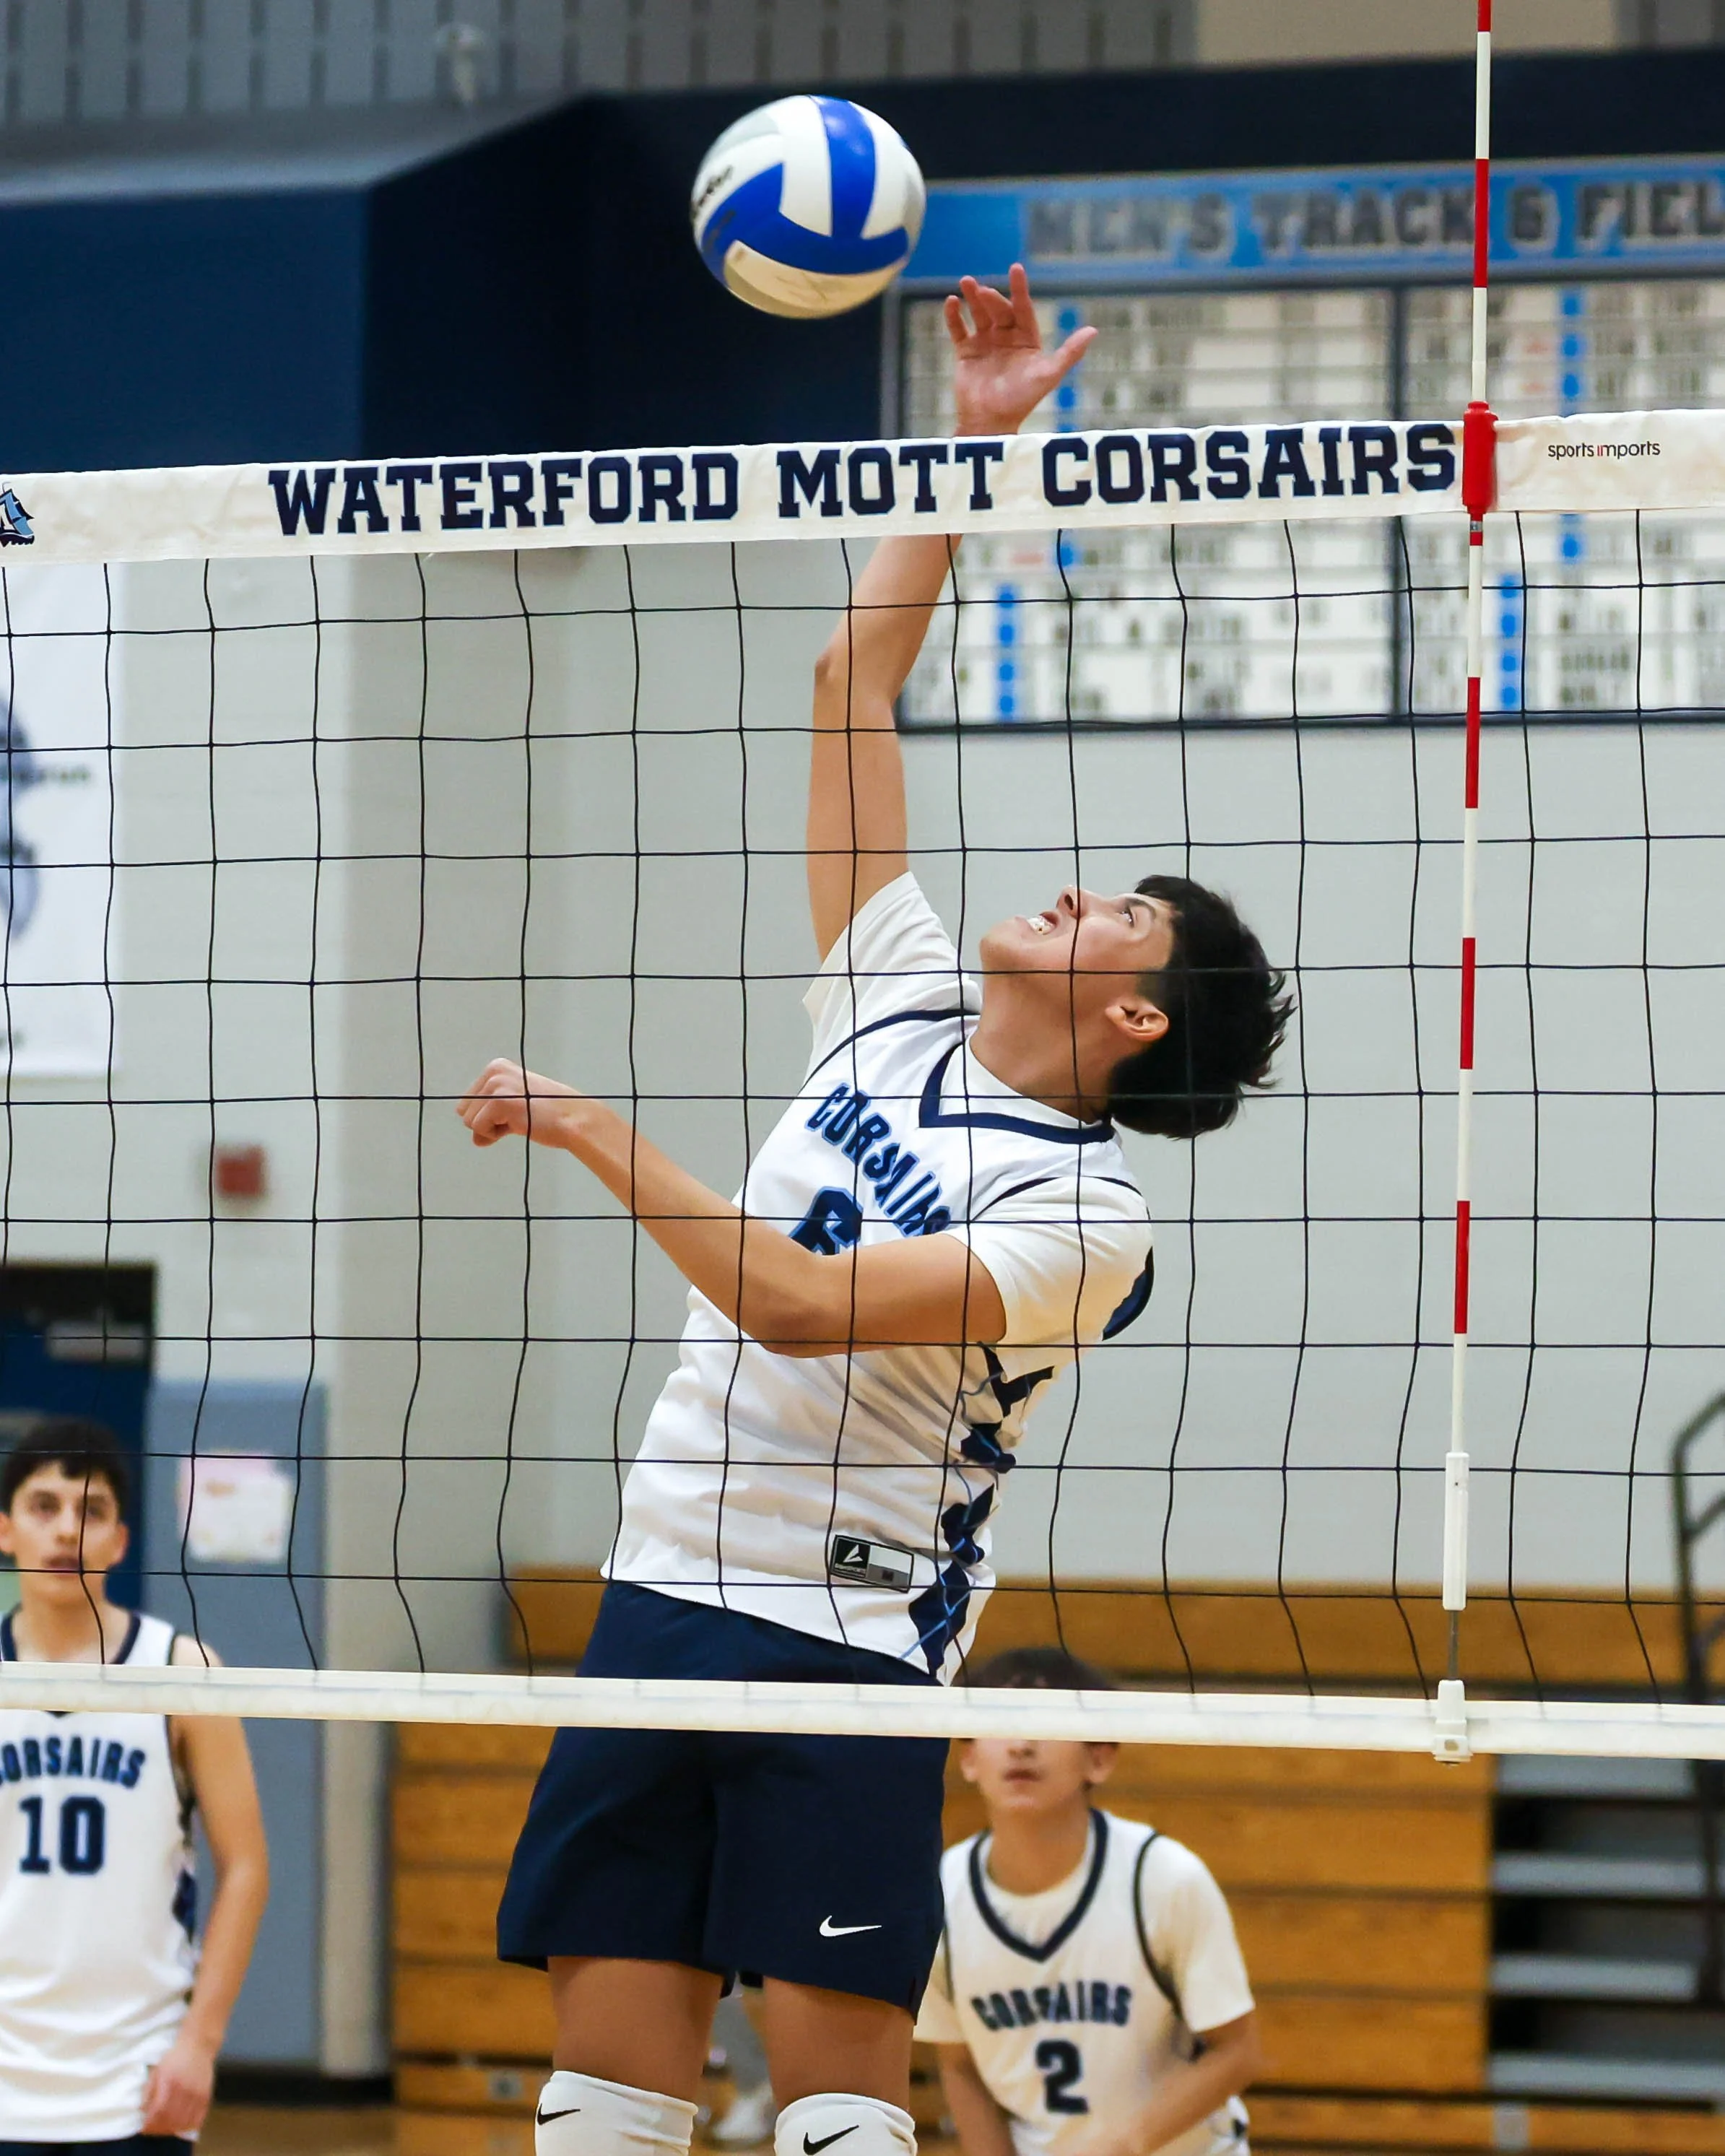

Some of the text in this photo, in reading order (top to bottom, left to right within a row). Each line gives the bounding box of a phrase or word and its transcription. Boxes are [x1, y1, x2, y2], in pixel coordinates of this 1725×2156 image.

[1252, 185, 1477, 256] TRACK
[268, 424, 1455, 536] WATERFORD MOTT CORSAIRS
[1547, 440, 1661, 461] sports imports
[0, 1735, 145, 1789] ORSAIRS
[19, 1795, 106, 1875] 10
[970, 1981, 1132, 2033] CORSAIRS
[1035, 2038, 1090, 2115] 2
